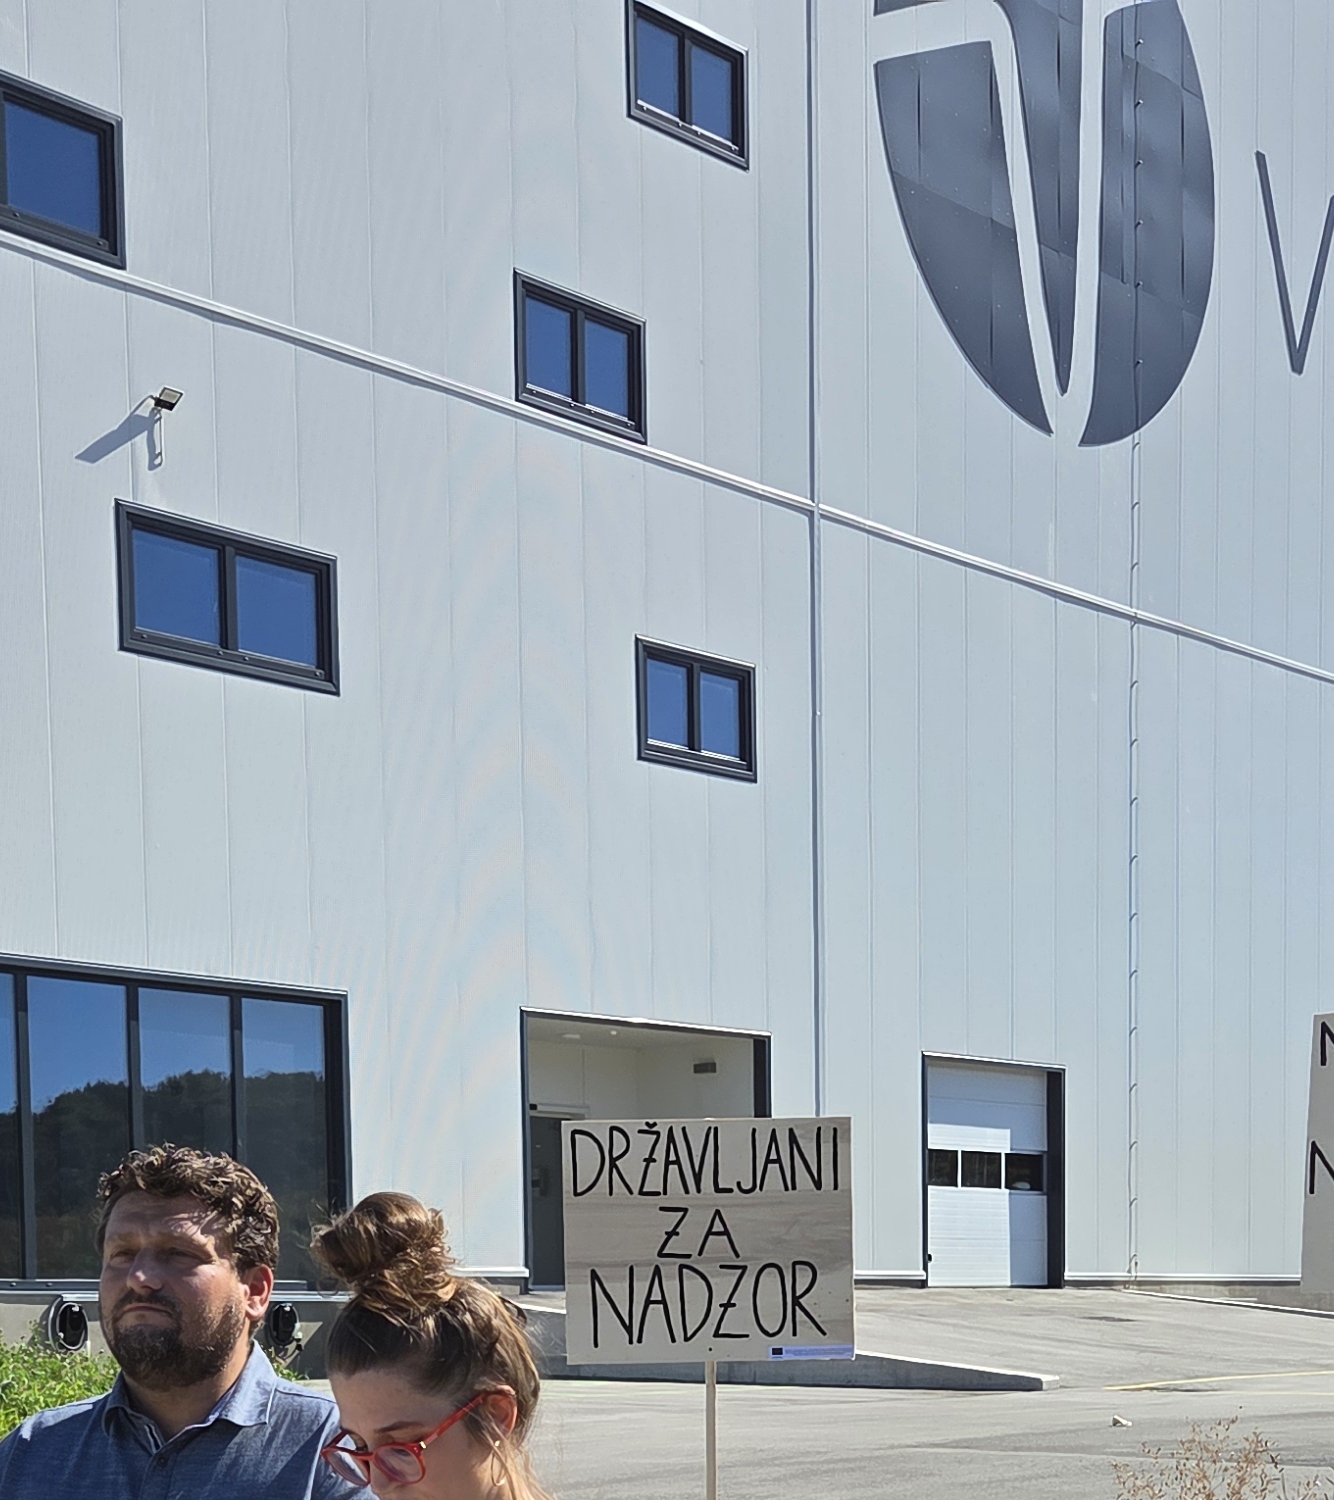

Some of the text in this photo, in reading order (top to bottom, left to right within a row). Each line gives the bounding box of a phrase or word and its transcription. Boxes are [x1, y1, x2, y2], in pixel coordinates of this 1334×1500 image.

[570, 1121, 839, 1197] DRŽAVLJANI
[656, 1205, 741, 1260] ZA
[590, 1260, 827, 1349] NADZOR
